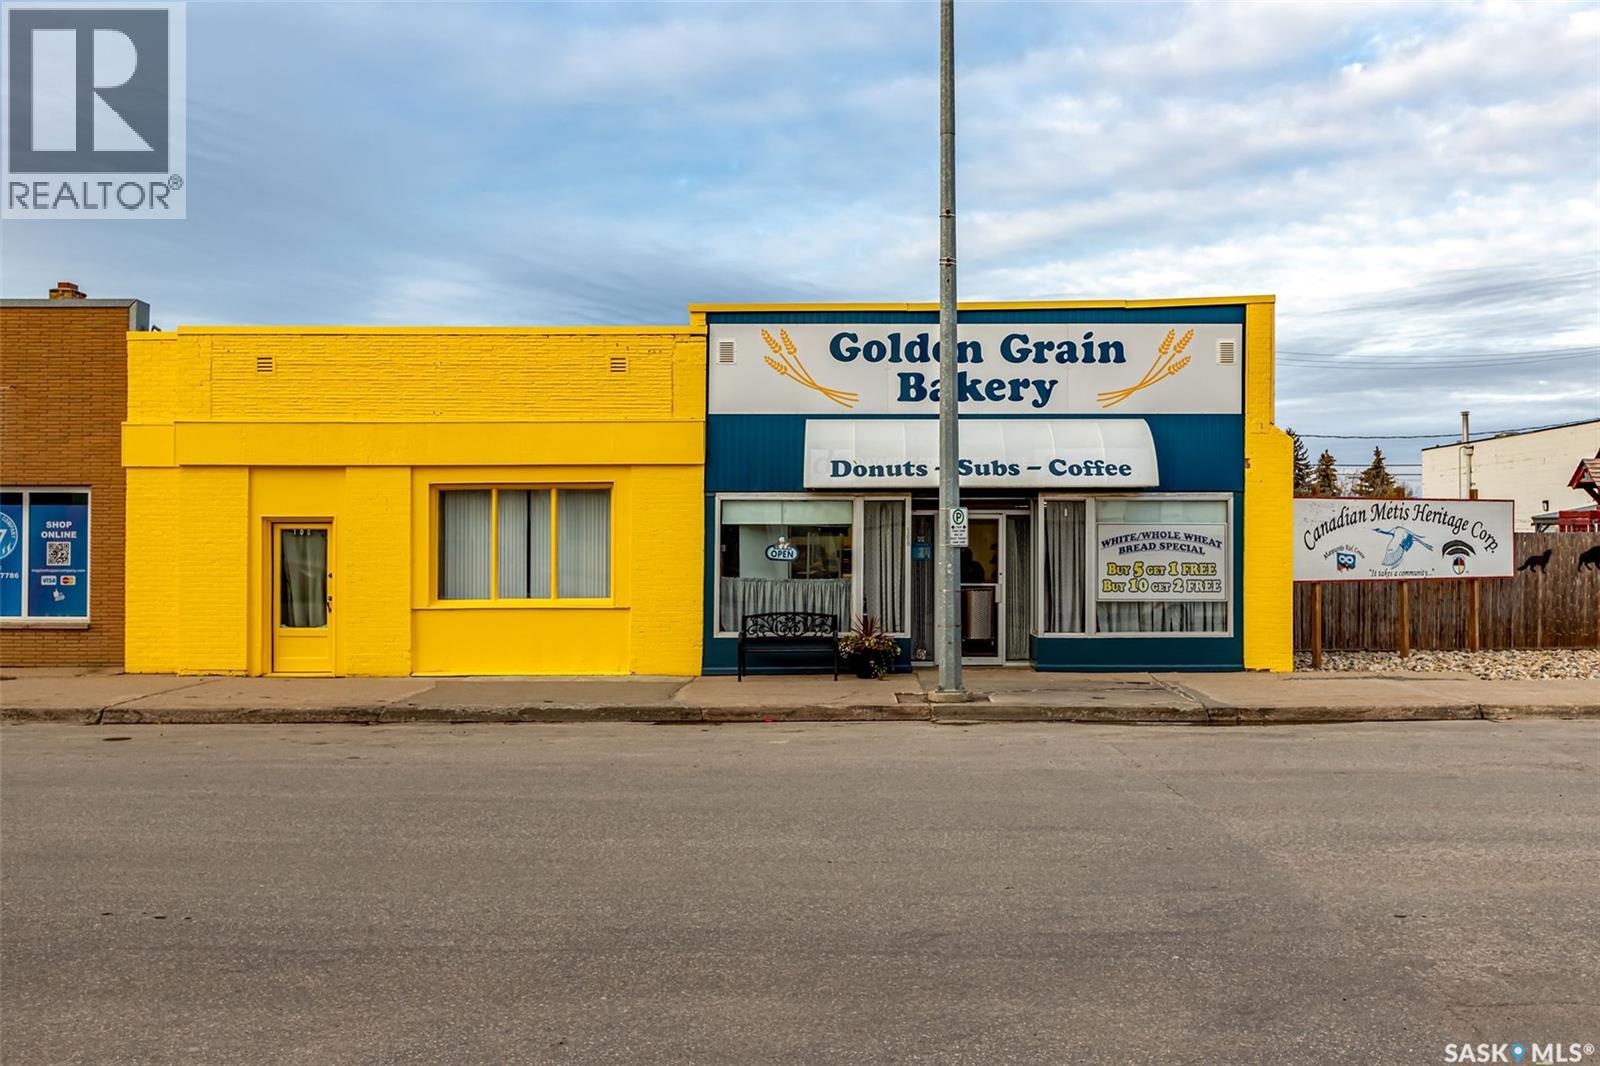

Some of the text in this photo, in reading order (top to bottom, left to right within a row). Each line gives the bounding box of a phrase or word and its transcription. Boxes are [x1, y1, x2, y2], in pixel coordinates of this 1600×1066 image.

[1000, 331, 1127, 364] Grain
[830, 460, 928, 478] Donuts
[957, 459, 1021, 477] Subs
[1048, 458, 1132, 477] Coffee
[46, 521, 72, 529] SHOP
[1303, 505, 1368, 551] Canadian
[1412, 503, 1469, 535] Heritage
[1471, 521, 1499, 554] Corp.
[41, 531, 77, 539] ONLINE
[1101, 531, 1223, 549] WHITE/WHOLE WHEAT
[771, 550, 794, 558] OPEN
[1118, 542, 1206, 555] BREAD SPECIAL
[1133, 561, 1144, 578] 5
[1168, 561, 1178, 576] 1
[1181, 562, 1217, 576] FREE
[1128, 578, 1149, 592] 10
[1173, 578, 1184, 593] 2
[1186, 579, 1222, 593] FREE
